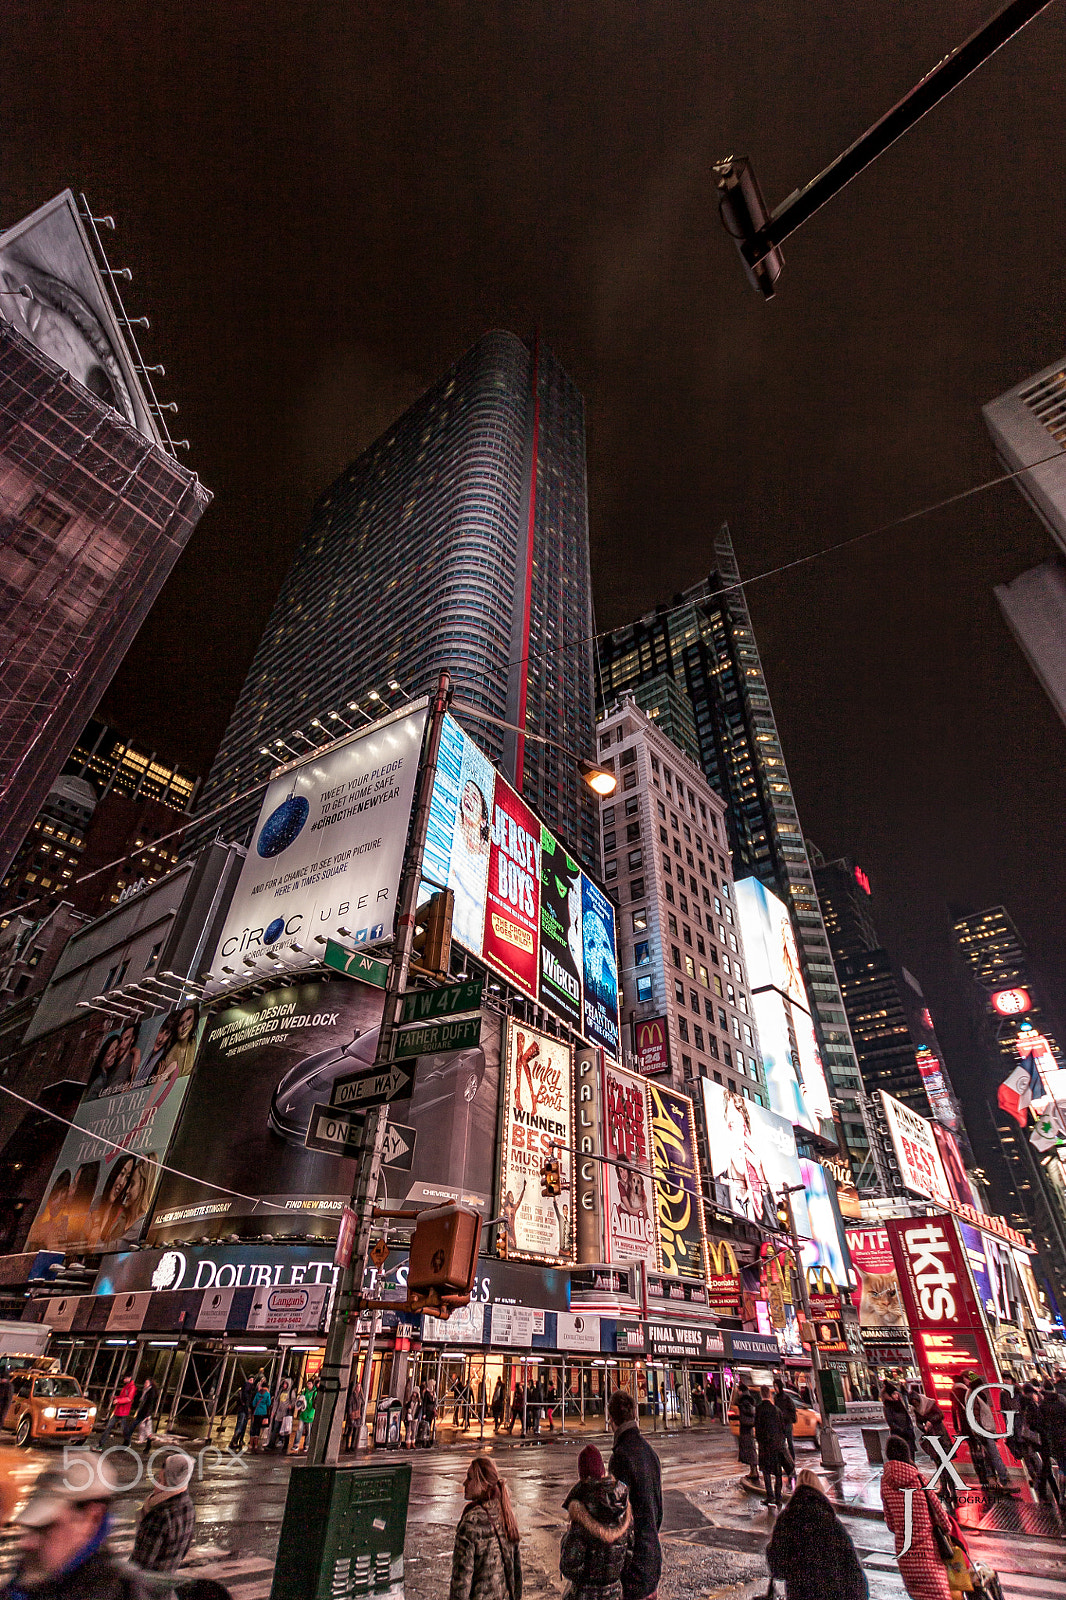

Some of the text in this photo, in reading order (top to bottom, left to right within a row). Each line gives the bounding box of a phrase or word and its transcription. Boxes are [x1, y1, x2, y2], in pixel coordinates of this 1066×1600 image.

[320, 758, 404, 802] TWEET YOUR PLEDGE
[321, 774, 395, 814] TO GET HOME SAFE
[490, 804, 542, 881] JERSEY
[265, 878, 278, 891] FOR
[278, 877, 284, 886] A
[284, 866, 309, 884] CHANCE
[310, 863, 318, 875] TO
[319, 857, 333, 871] SEE
[334, 850, 352, 866] YOUR
[352, 837, 382, 857] PICTURE
[274, 861, 350, 898] HERE IN TIMES SQUARE
[498, 850, 536, 920] BOYS
[319, 887, 390, 923] UBER
[495, 924, 513, 939] GOES
[343, 951, 374, 972] 7 AV
[421, 984, 480, 1015] W 47 ST
[597, 1001, 607, 1015] THE
[207, 1018, 244, 1042] FUNCTION
[260, 1002, 297, 1021] DESIGN
[219, 1013, 340, 1050] IN ENGINEERED WEDLOCK
[584, 999, 619, 1040] PHANTOM
[586, 1015, 594, 1028] OF
[594, 1022, 603, 1037] THE
[603, 1027, 617, 1047] OPERA
[270, 1033, 290, 1043] POST
[399, 1021, 480, 1048] FATHER DUFFY
[422, 1040, 452, 1052] SQUARE
[642, 1045, 663, 1055] OPEN
[645, 1052, 661, 1065] 24
[340, 1072, 401, 1100] ONE WAY
[513, 1031, 562, 1116] Kinky
[107, 1089, 150, 1116] WE'RE
[536, 1084, 567, 1112] Boots
[608, 1094, 645, 1123] HARD
[625, 1086, 644, 1107] THE
[87, 1106, 158, 1137] STRONGER
[513, 1107, 567, 1138] WINNER!
[580, 1060, 594, 1211] PALACE
[326, 1121, 401, 1153] ONE AY
[511, 1124, 567, 1160] BEST
[608, 1126, 648, 1160] LIFE
[901, 1135, 939, 1180] BEST
[528, 1168, 541, 1178] TON
[422, 1188, 459, 1200] CHEVROLET
[205, 1203, 232, 1216] STINGRAY
[612, 1203, 655, 1245] Annie
[845, 1231, 890, 1251] WTF
[594, 1274, 620, 1290] Annie
[904, 1223, 957, 1320] tkts
[272, 1295, 305, 1307] Langan's
[649, 1326, 702, 1344] FINAL WEEKS
[658, 1344, 696, 1355] GET TICKETS HERE
[706, 1335, 725, 1352] Annie
[733, 1339, 779, 1353] MONEY EXCHANGE
